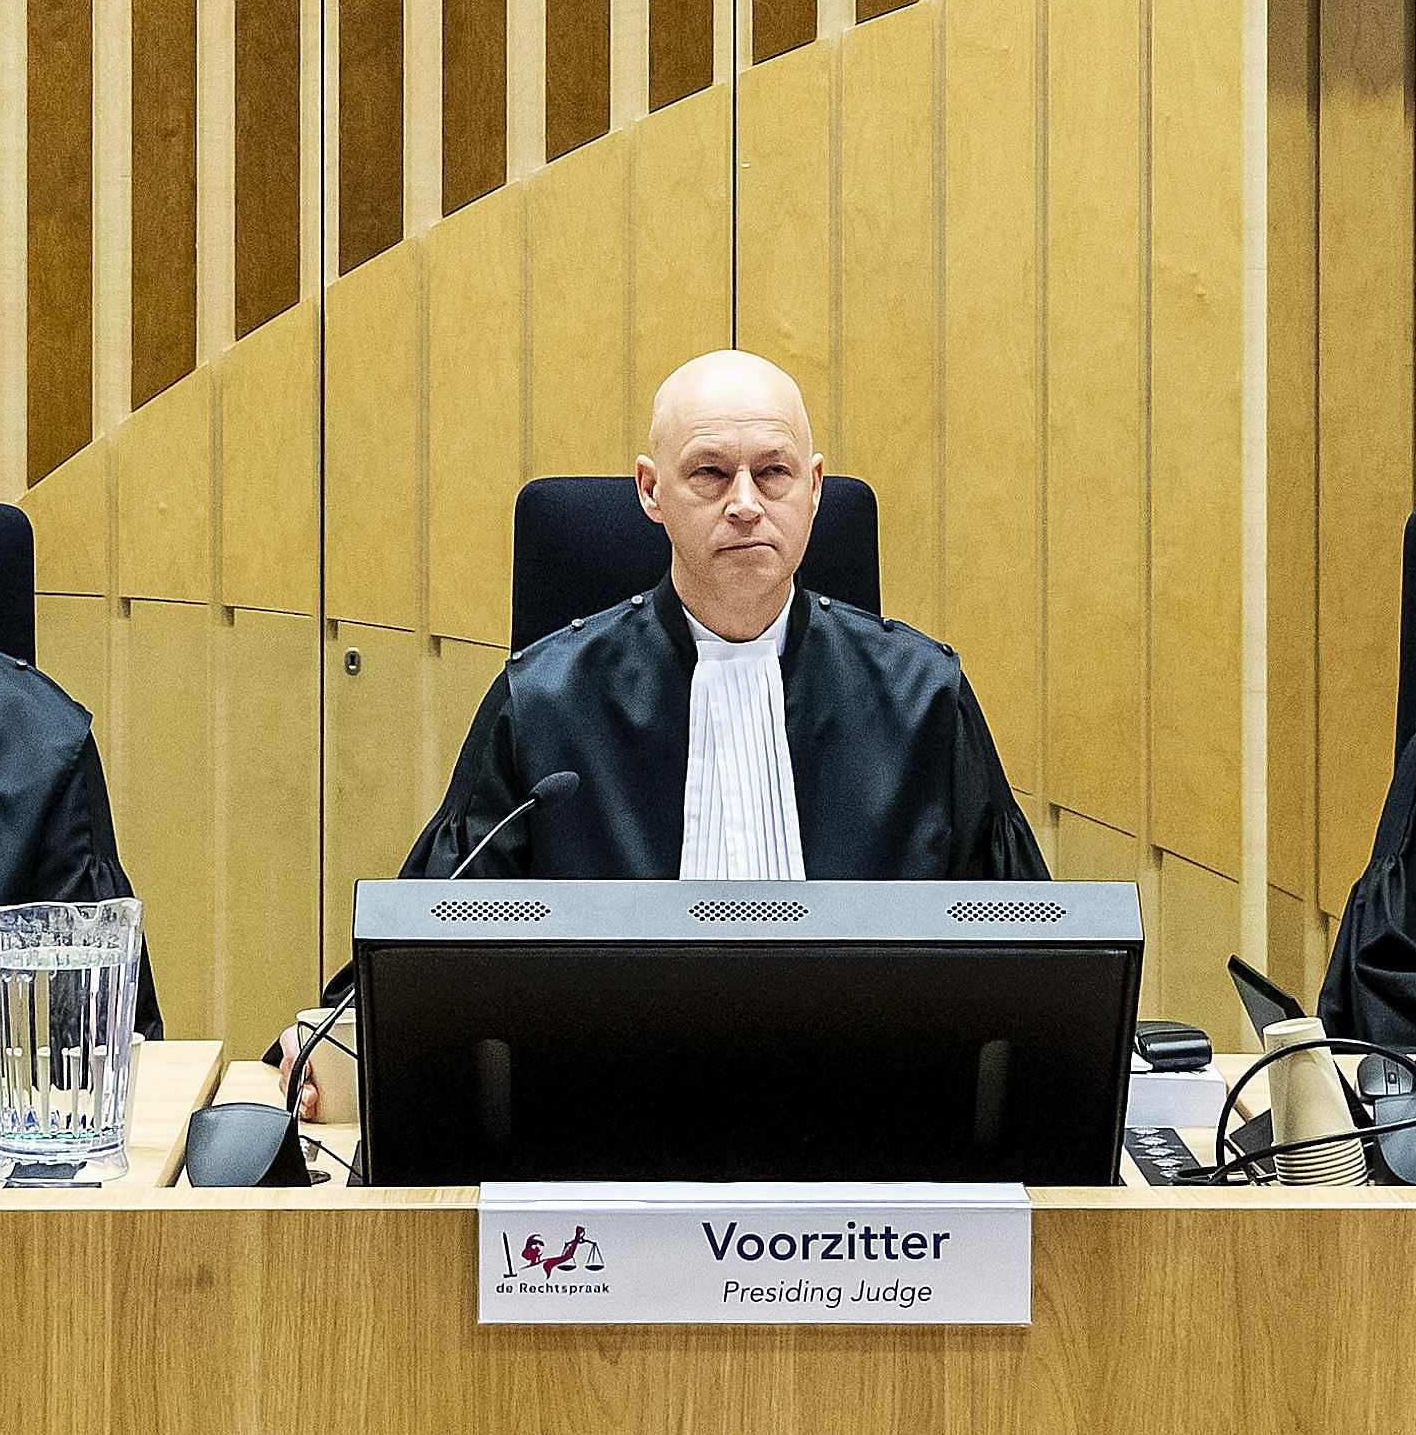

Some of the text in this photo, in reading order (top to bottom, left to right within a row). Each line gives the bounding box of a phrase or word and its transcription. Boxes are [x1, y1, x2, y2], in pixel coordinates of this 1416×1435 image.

[703, 1223, 951, 1262] Voorzitter
[496, 1283, 611, 1297] de Rechtspraak
[725, 1280, 933, 1309] Presiding Judge
